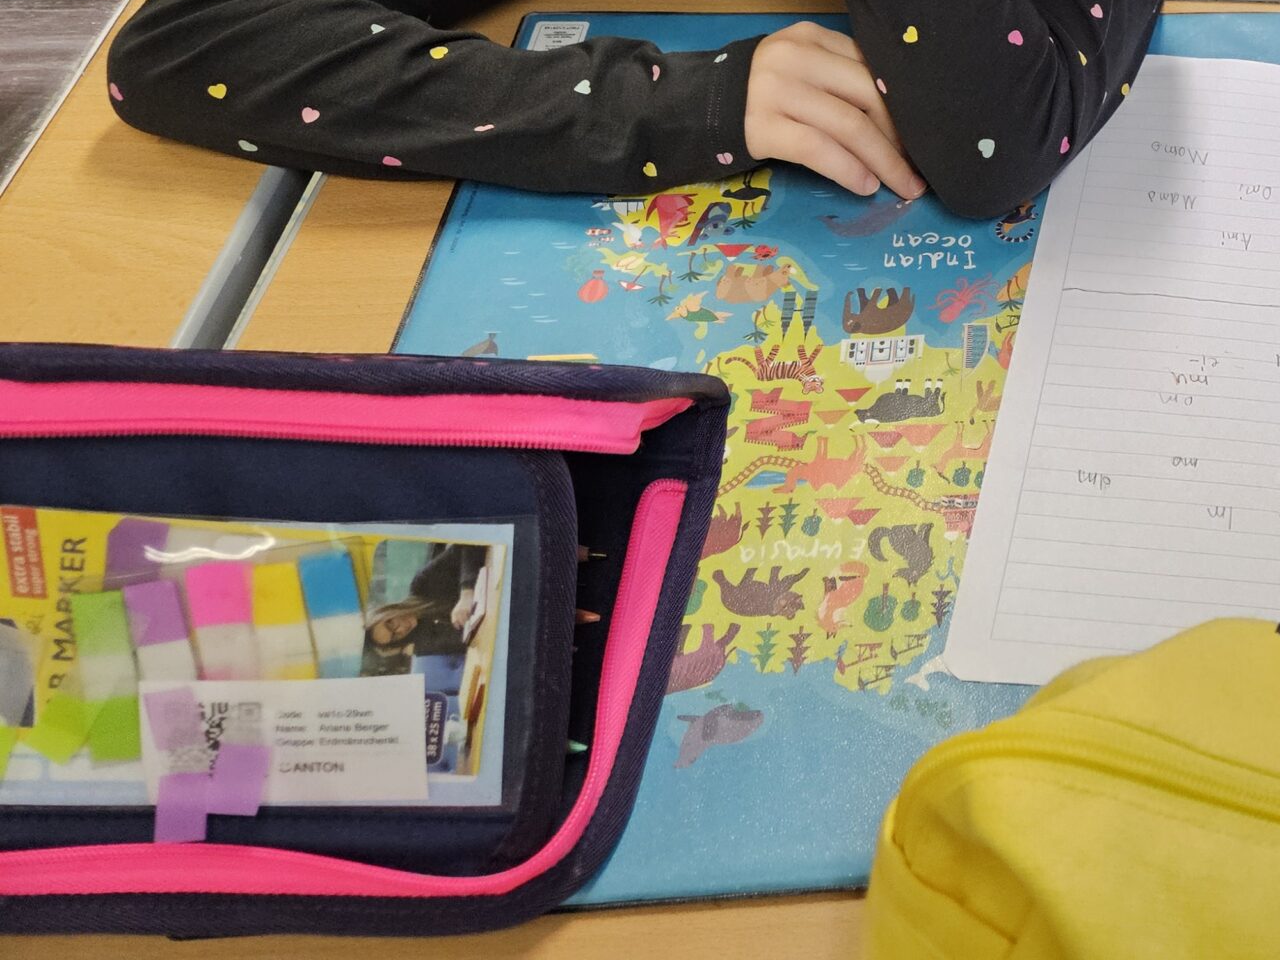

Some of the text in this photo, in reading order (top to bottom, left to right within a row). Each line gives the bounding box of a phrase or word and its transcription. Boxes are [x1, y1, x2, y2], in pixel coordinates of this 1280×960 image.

[1239, 183, 1272, 201] Omi
[892, 232, 973, 248] ocean
[883, 249, 977, 270] Indian
[4, 515, 31, 595] extra stabil
[29, 566, 45, 596] super
[53, 537, 88, 662] MARKER
[292, 761, 346, 773] ANTON
